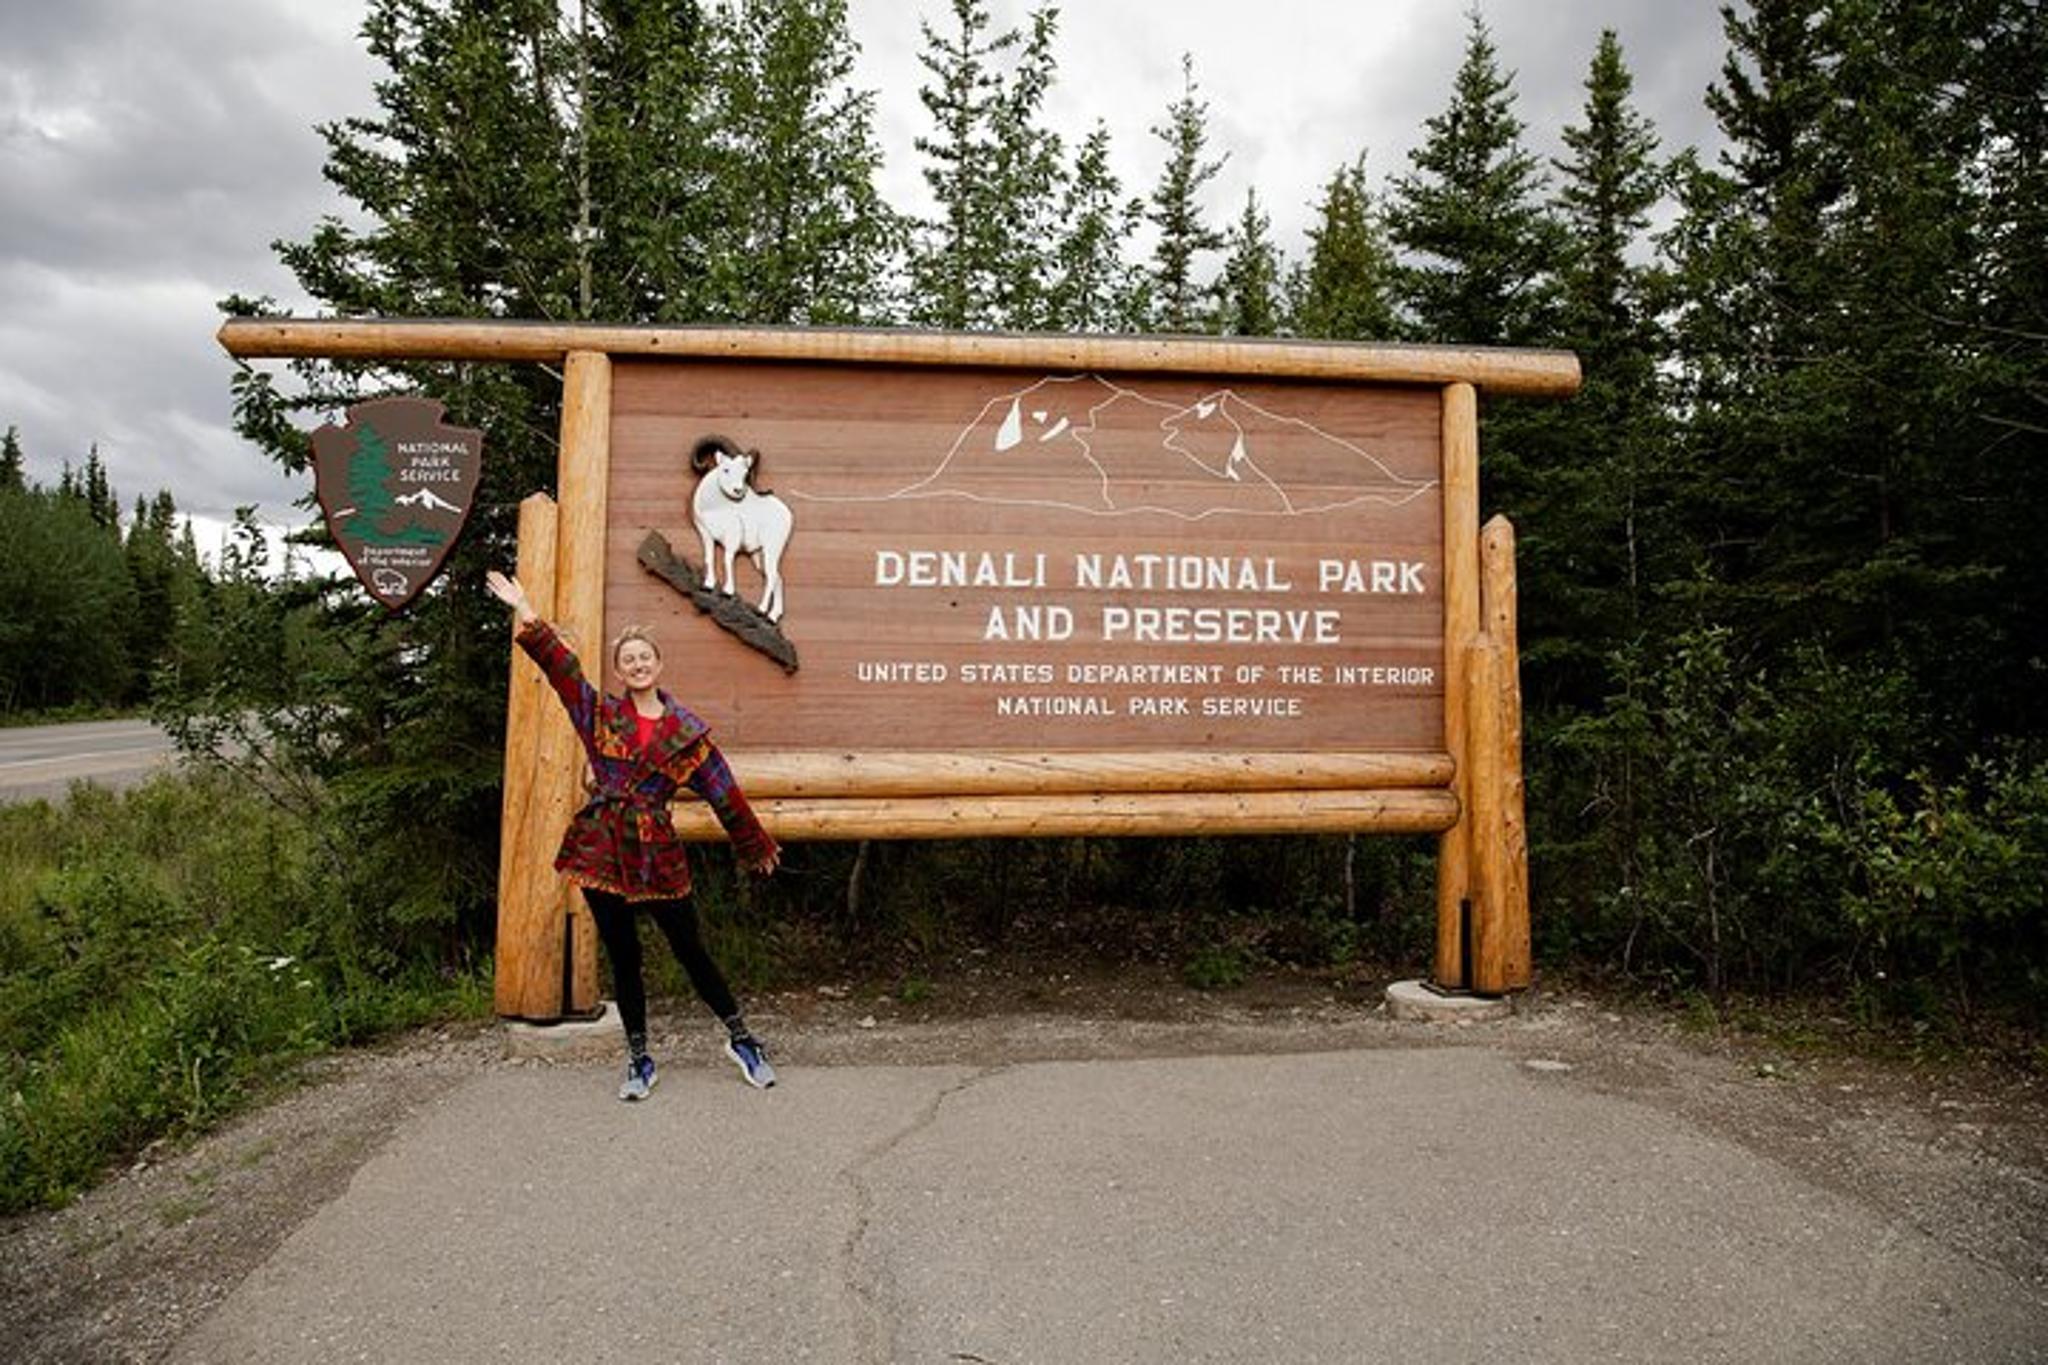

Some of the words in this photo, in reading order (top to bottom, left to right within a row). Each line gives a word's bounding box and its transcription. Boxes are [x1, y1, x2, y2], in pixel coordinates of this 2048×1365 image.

[398, 443, 468, 454] NATIONAL
[412, 458, 450, 467] PARK
[400, 469, 461, 481] SERVICE
[875, 550, 1047, 587] DENALI
[1076, 553, 1292, 592] NATIONAL
[1319, 559, 1426, 595] PARK
[984, 606, 1074, 641] AND
[1103, 608, 1342, 645] PRESERVE
[857, 662, 947, 683] UNITED
[960, 663, 1054, 683] STATES
[1067, 664, 1223, 685] DEPARTMENT
[1237, 666, 1266, 685] OF
[1279, 667, 1323, 686] THE
[1336, 667, 1435, 687] INTERIOR
[997, 697, 1115, 717] NATIONAL
[1129, 698, 1190, 717] PARK
[1203, 698, 1302, 718] SERVICE
